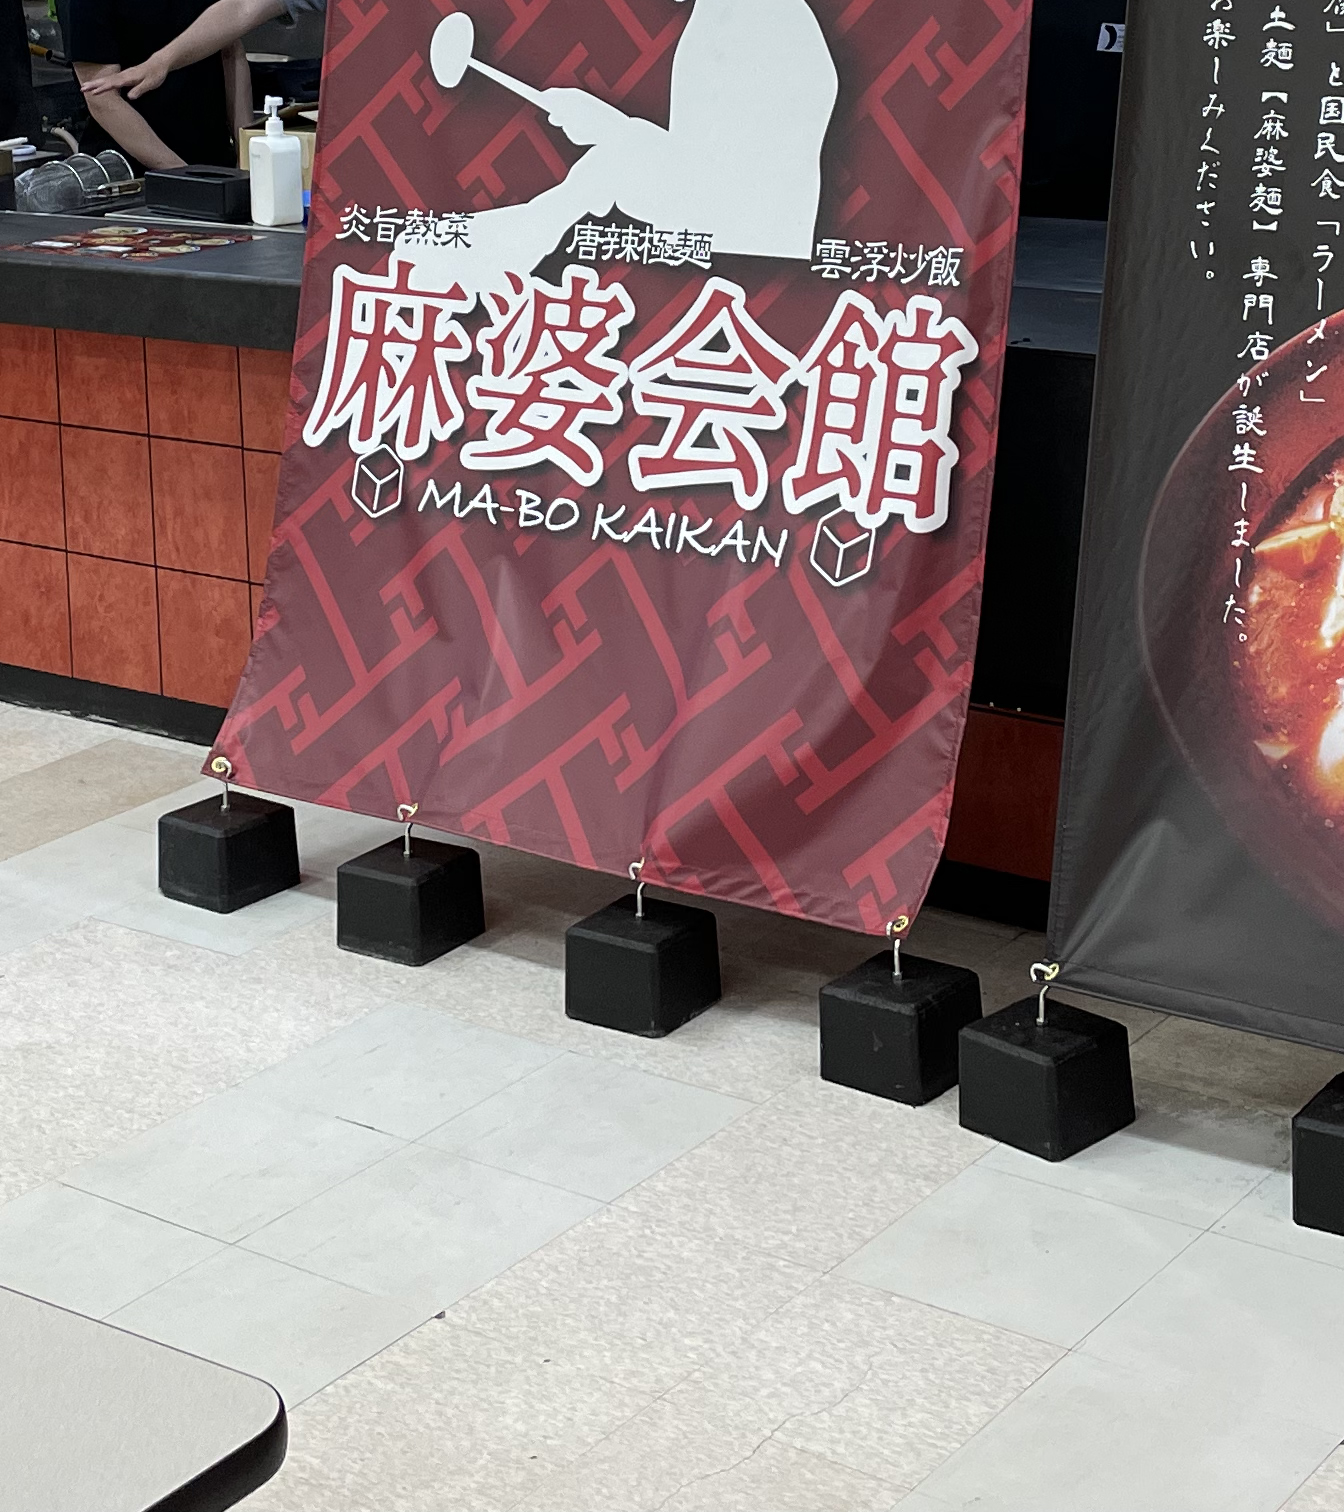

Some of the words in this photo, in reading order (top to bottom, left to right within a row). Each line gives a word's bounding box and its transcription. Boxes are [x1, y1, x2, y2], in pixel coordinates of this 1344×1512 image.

[811, 238, 966, 288] 雲浮炒飯
[302, 258, 978, 533] 麻婆会館
[418, 480, 580, 532] MA-BO
[592, 502, 789, 568] KAIKAN
